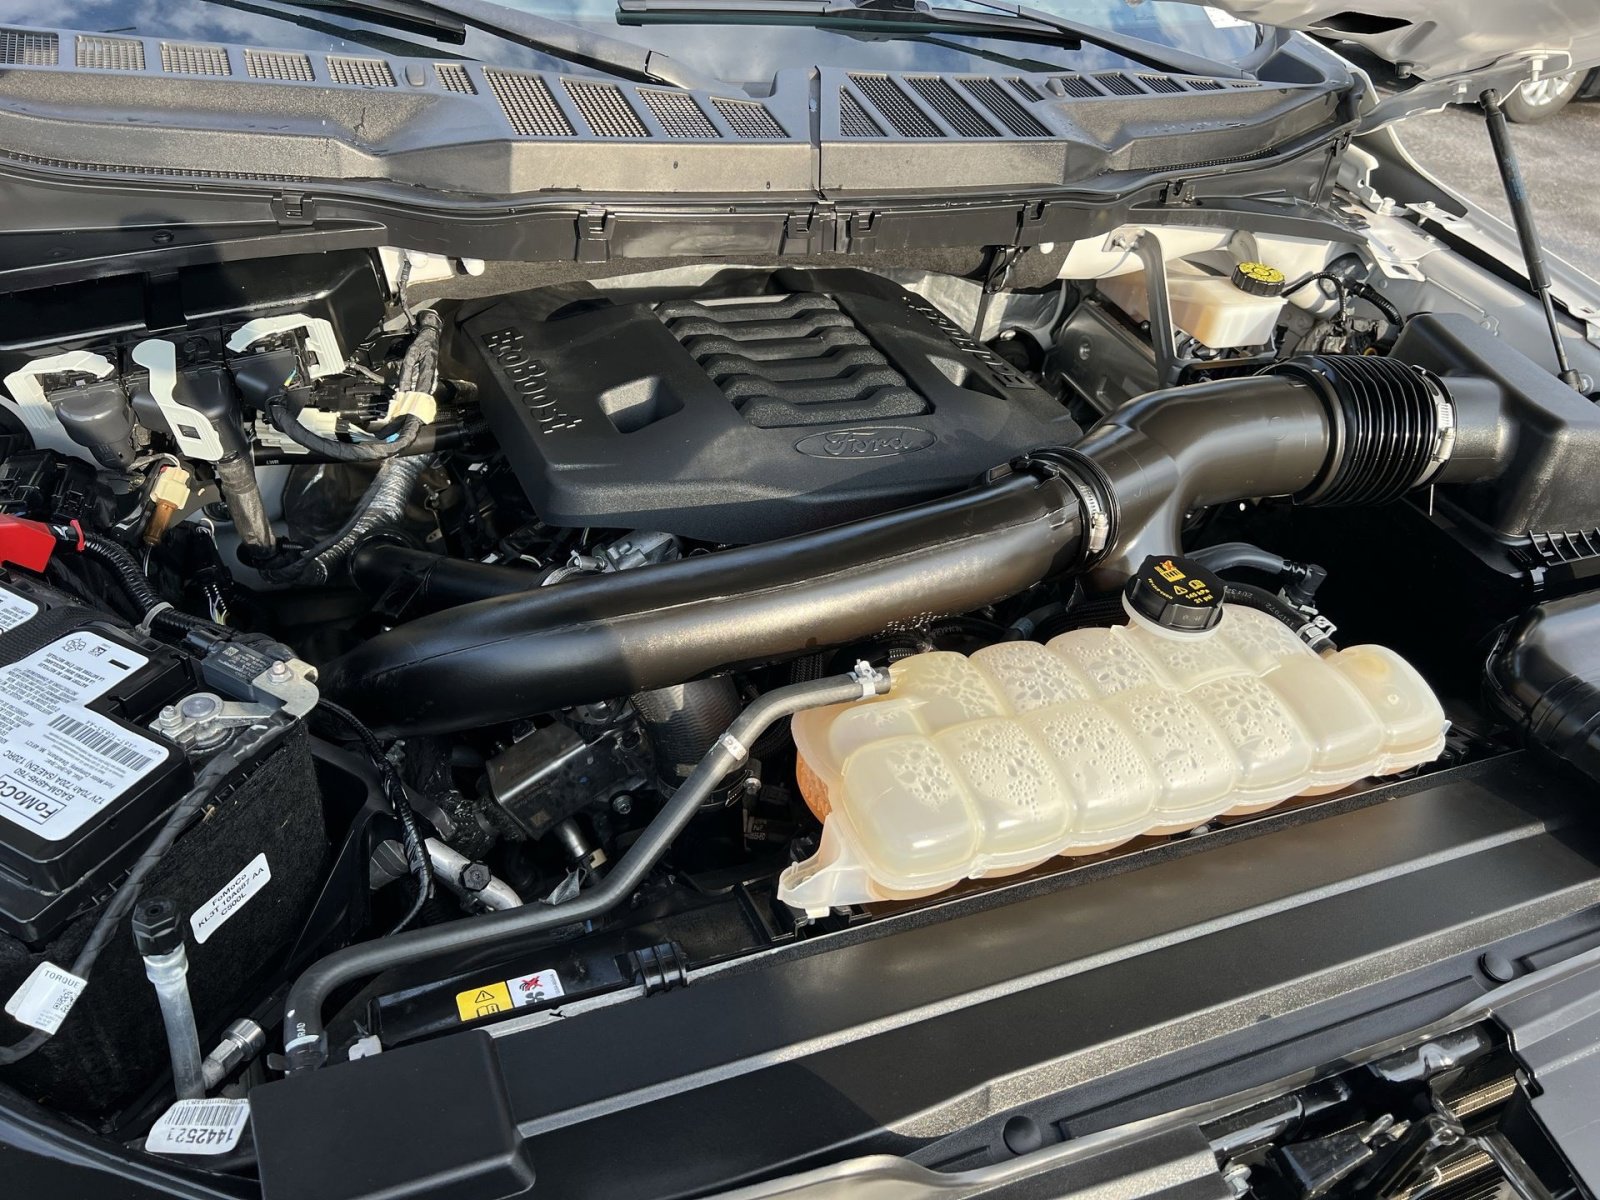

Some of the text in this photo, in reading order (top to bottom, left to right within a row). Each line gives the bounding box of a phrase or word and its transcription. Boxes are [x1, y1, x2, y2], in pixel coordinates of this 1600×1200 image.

[824, 431, 917, 456] Ford
[3, 750, 28, 765] 120RC
[90, 795, 107, 805] 12V
[198, 906, 220, 928] KL3T
[252, 867, 265, 880] AA
[212, 874, 247, 906] FoMoCo
[221, 893, 246, 916] C500L
[44, 969, 81, 989] TORQUE
